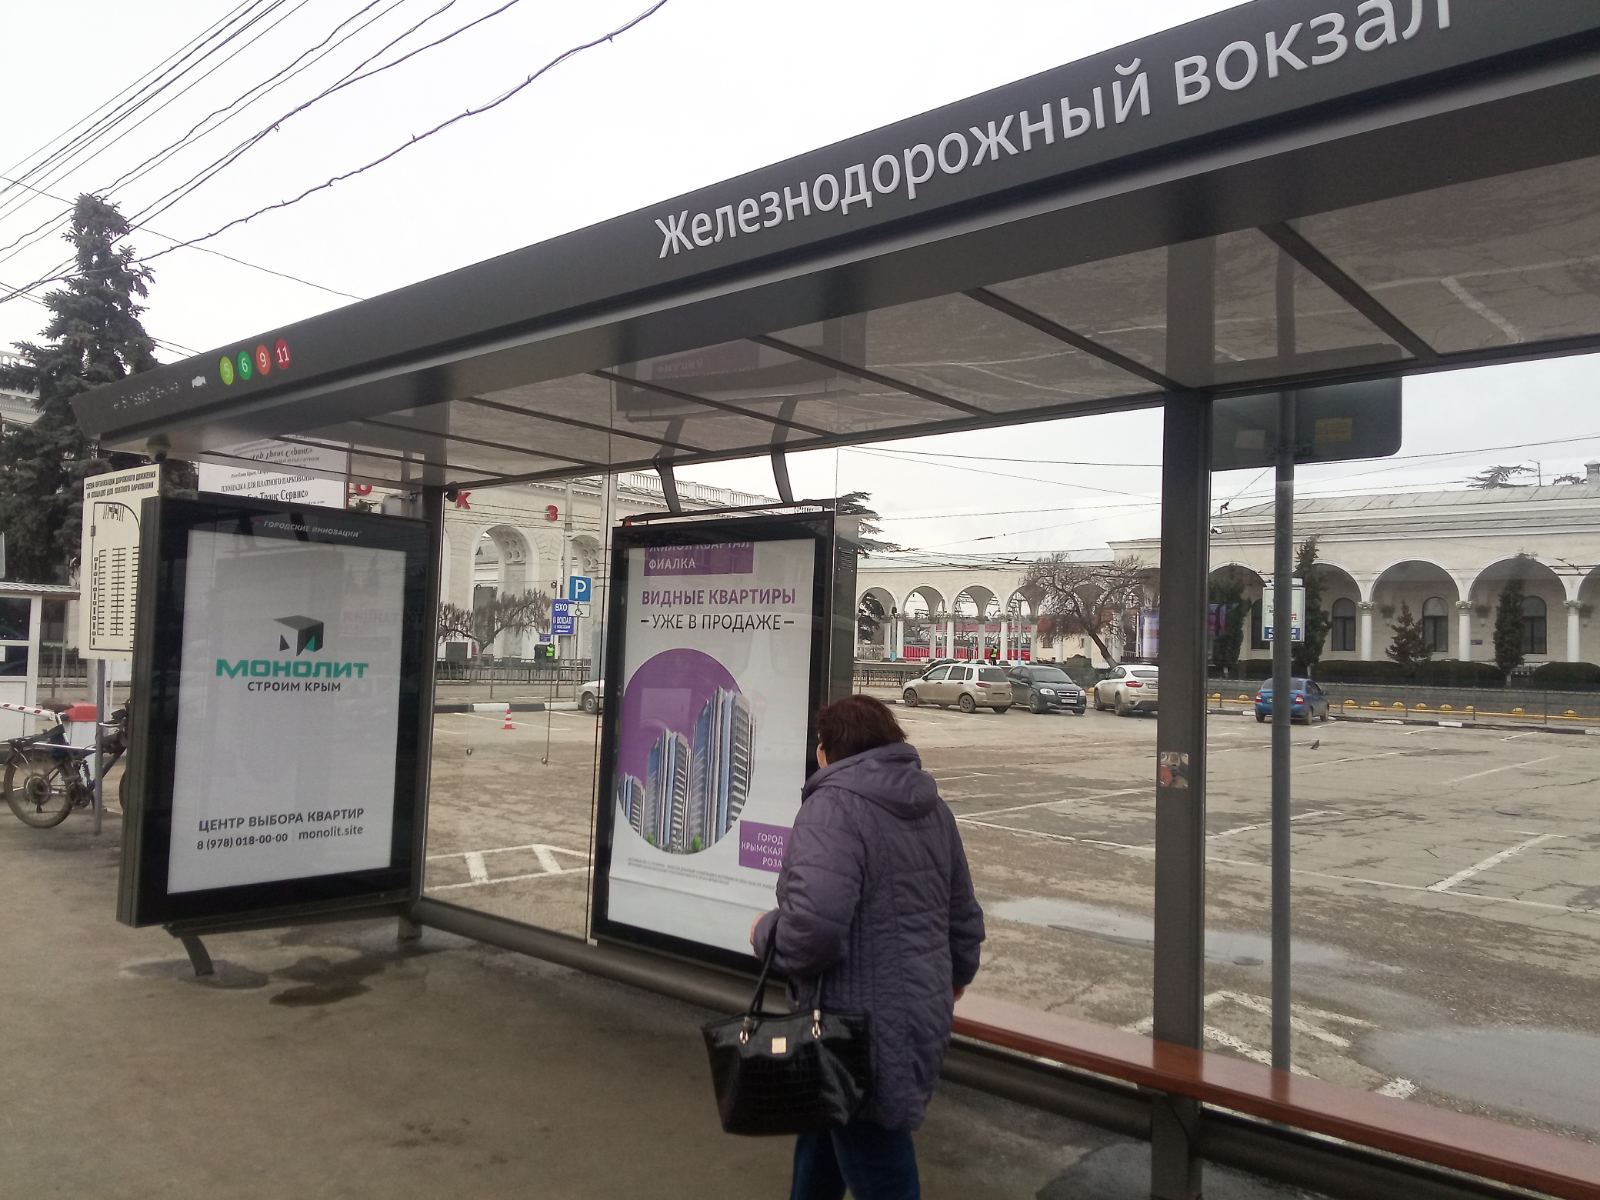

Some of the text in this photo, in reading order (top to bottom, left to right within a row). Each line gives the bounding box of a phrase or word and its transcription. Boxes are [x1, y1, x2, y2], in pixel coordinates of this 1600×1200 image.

[655, 0, 1451, 259] Железнодорожный вокзал
[241, 358, 248, 373] 6
[259, 352, 267, 368] 9
[276, 345, 290, 363] 11
[648, 557, 696, 570] ФИАЛКА
[641, 588, 796, 608] ВИДНЫЕ КВАРТИРЫ
[688, 614, 697, 629] В
[215, 659, 369, 680] МОНОЛИТ
[247, 681, 341, 692] СТРОИМ КРЫМ
[198, 807, 365, 833] ЦЕНТР ВЫБОРА КВАРТИР
[196, 825, 364, 851] 8 (978) 018-00-00 monolit.site
[758, 832, 783, 845] ГОРОД
[742, 841, 783, 855] КРЫМСКАЯ
[763, 857, 782, 867] РОЗА
